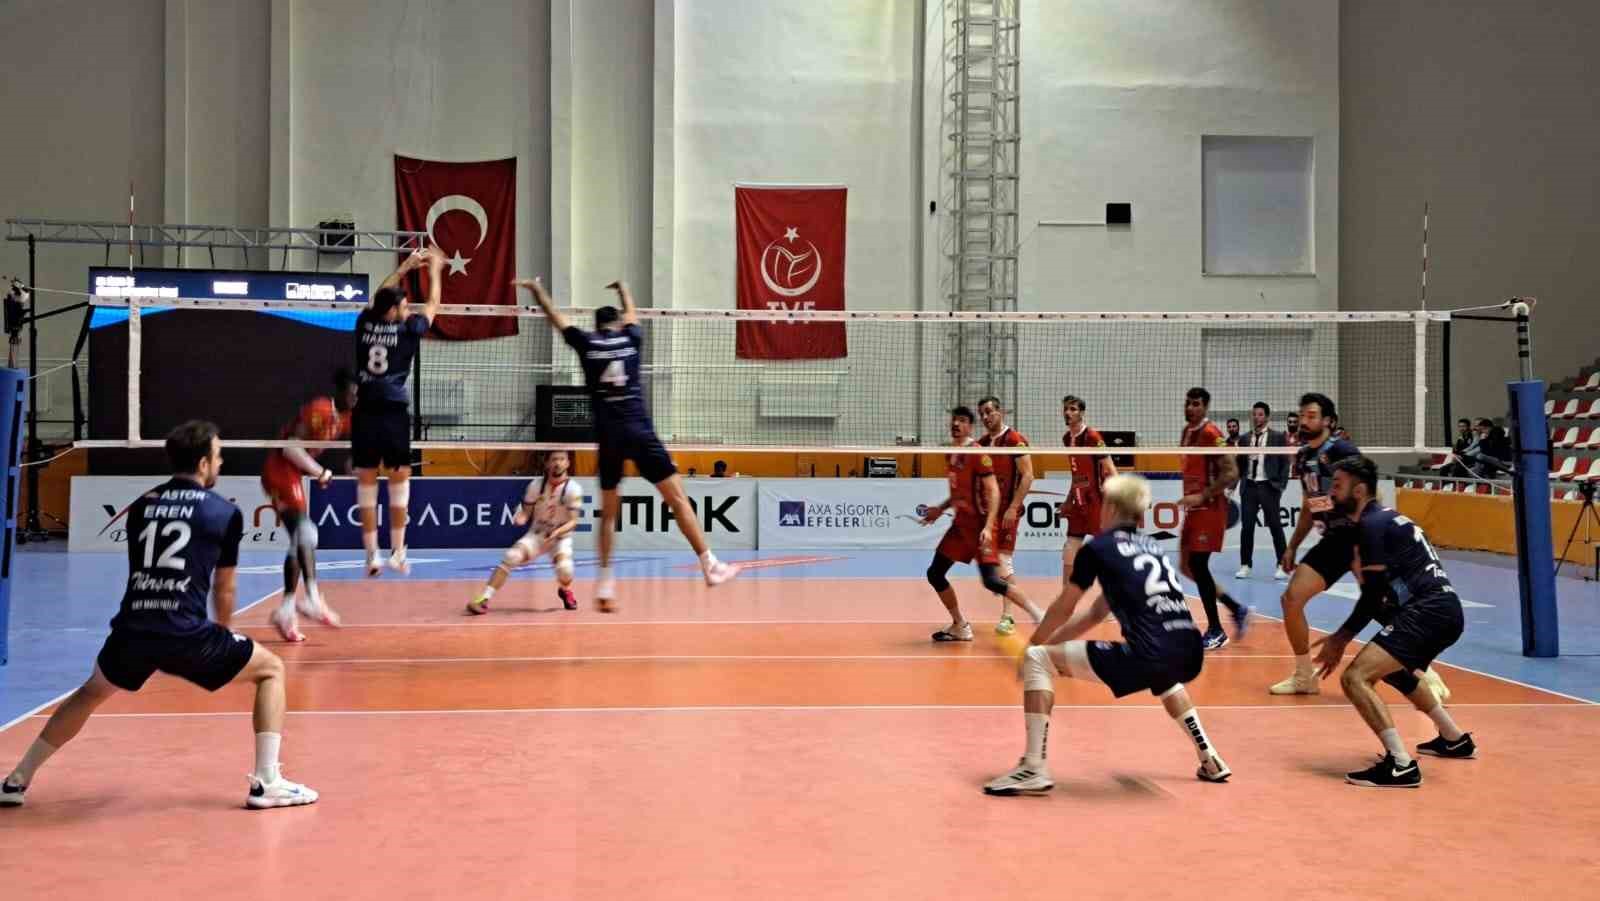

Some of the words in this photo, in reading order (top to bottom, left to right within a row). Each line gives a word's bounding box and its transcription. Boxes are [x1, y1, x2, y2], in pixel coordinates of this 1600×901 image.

[766, 302, 816, 325] TVF
[367, 345, 389, 375] 8
[599, 360, 629, 386] 4
[143, 505, 194, 519] EREN
[318, 503, 525, 526] ACIADEM
[807, 504, 830, 516] AXA
[138, 520, 192, 570] 12
